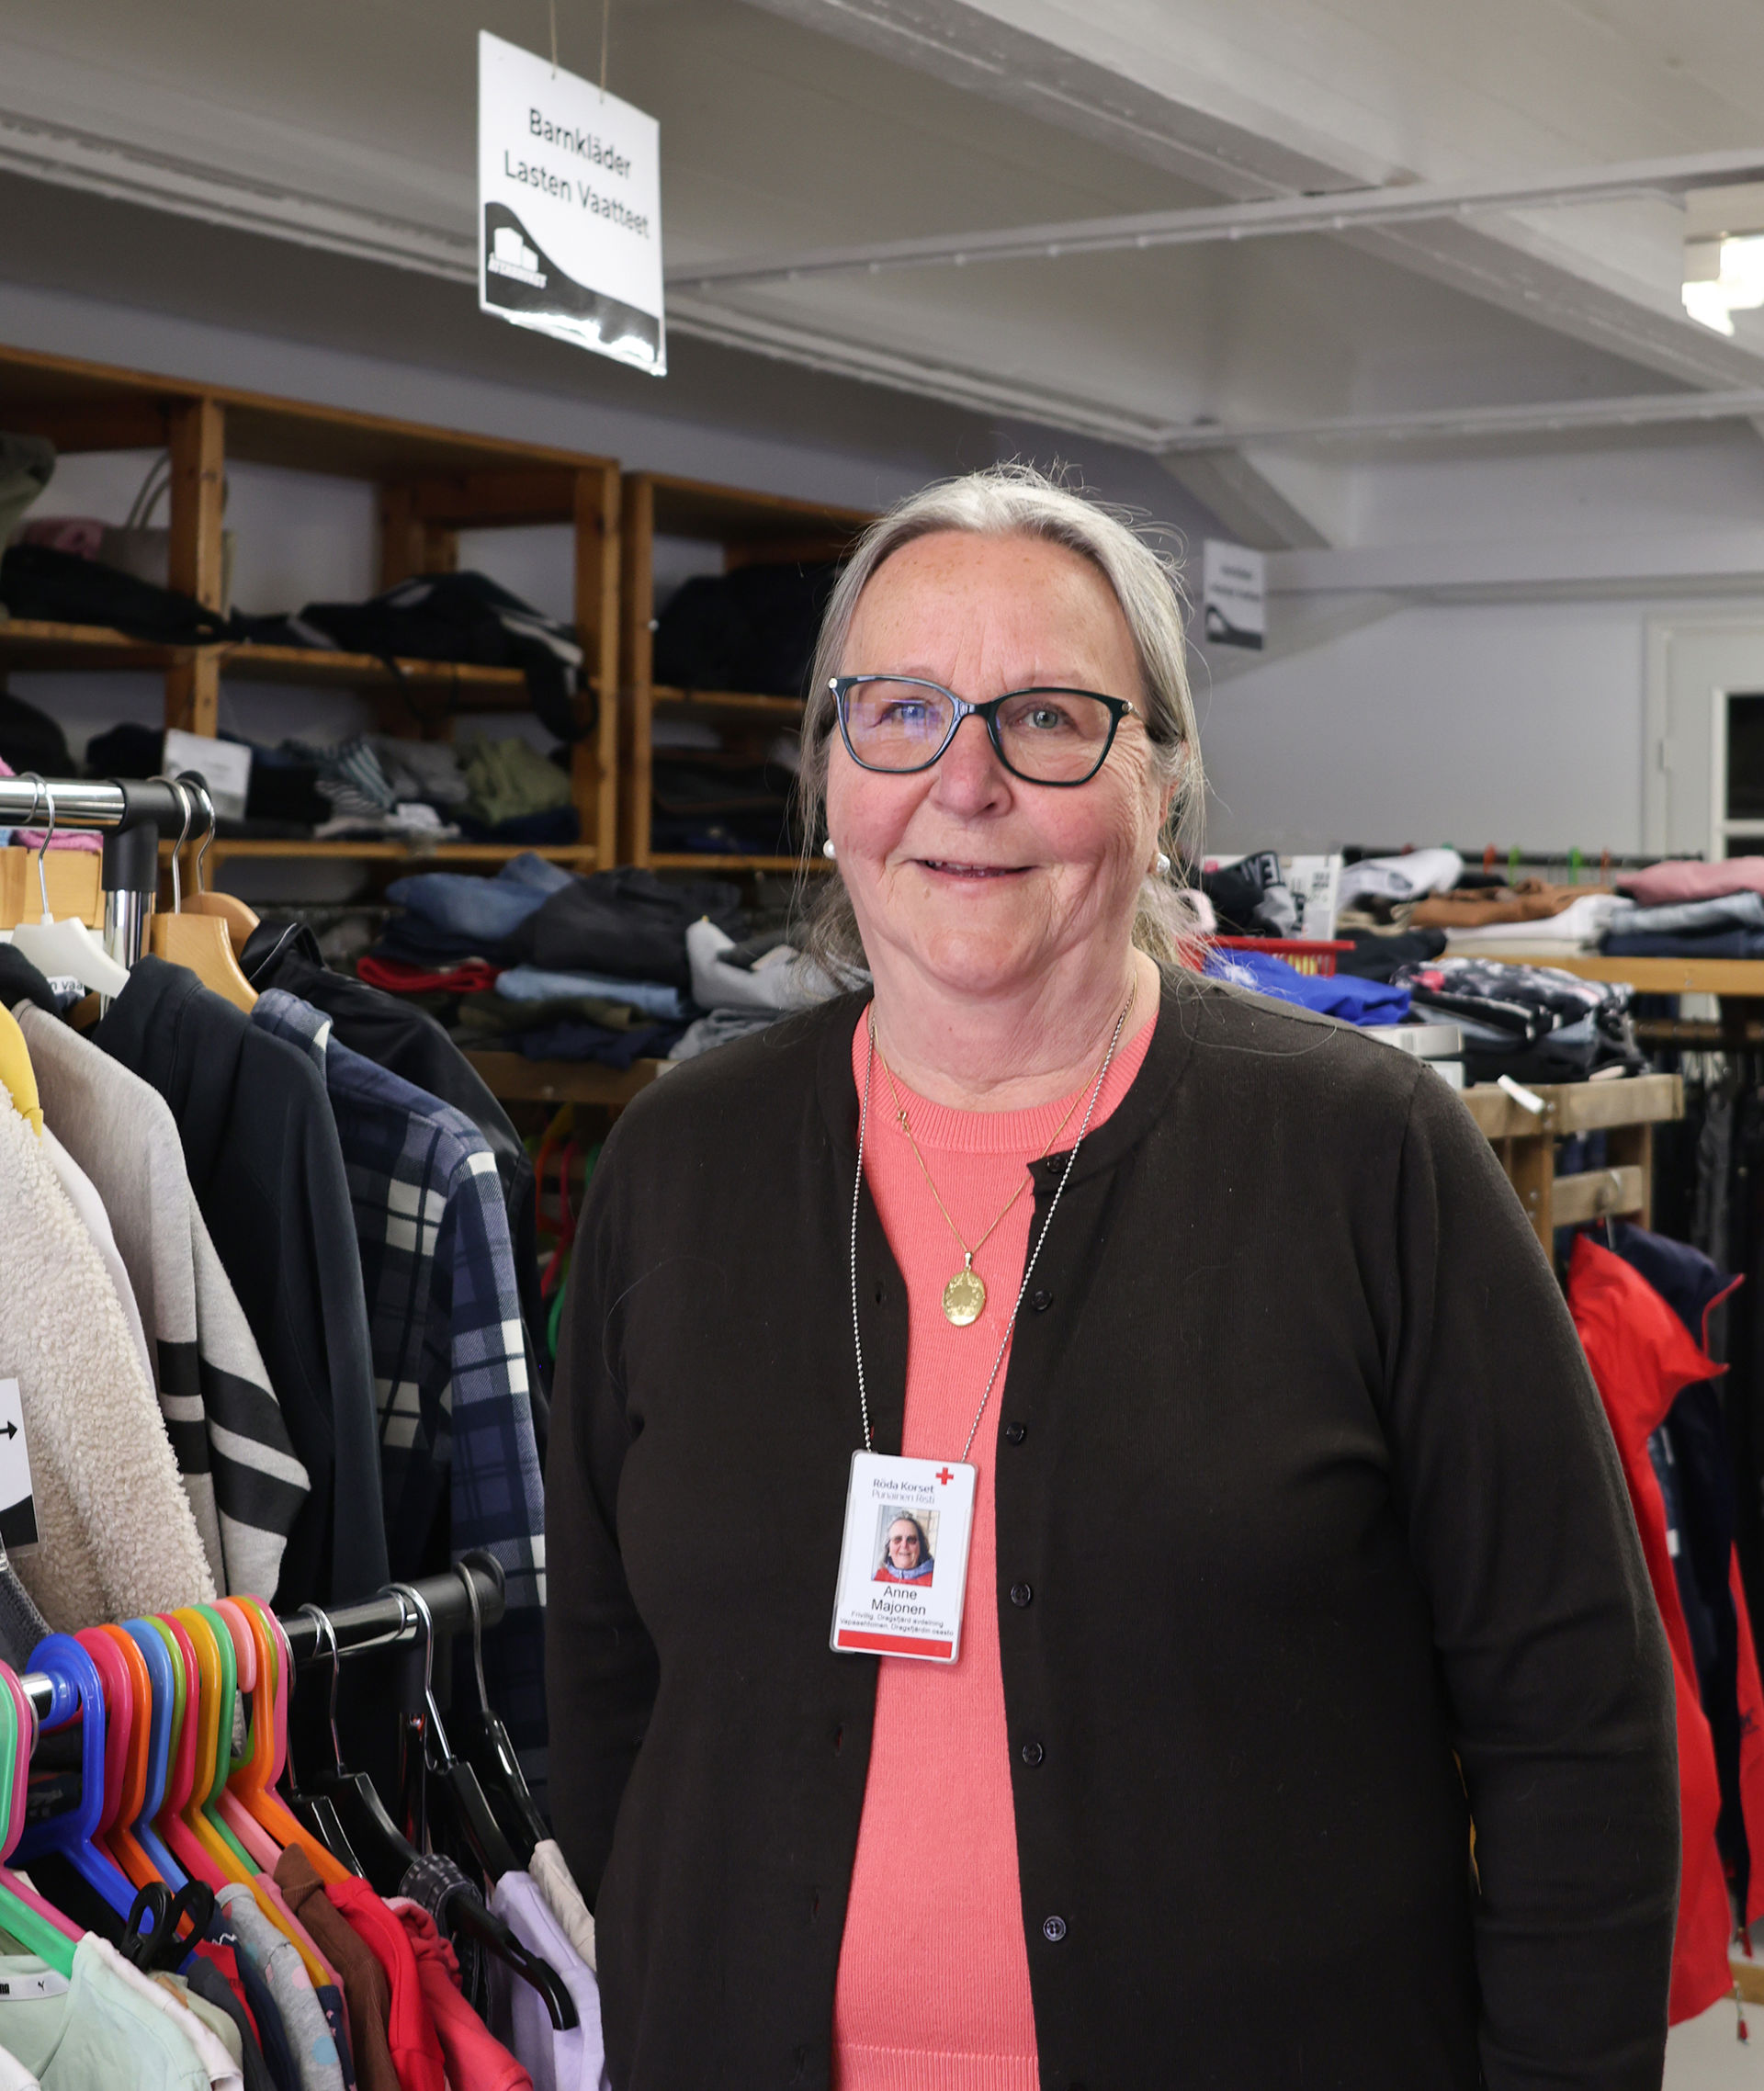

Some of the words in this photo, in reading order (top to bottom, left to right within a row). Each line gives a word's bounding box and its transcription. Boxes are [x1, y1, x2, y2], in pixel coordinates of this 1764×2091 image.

[529, 107, 631, 180] Barnkläder
[504, 149, 571, 202] Lasten
[578, 180, 650, 241] Vaatteet
[873, 1477, 899, 1490] Röda
[900, 1480, 934, 1494] Korset
[883, 1585, 918, 1600] Anne
[871, 1598, 926, 1616] Majonen
